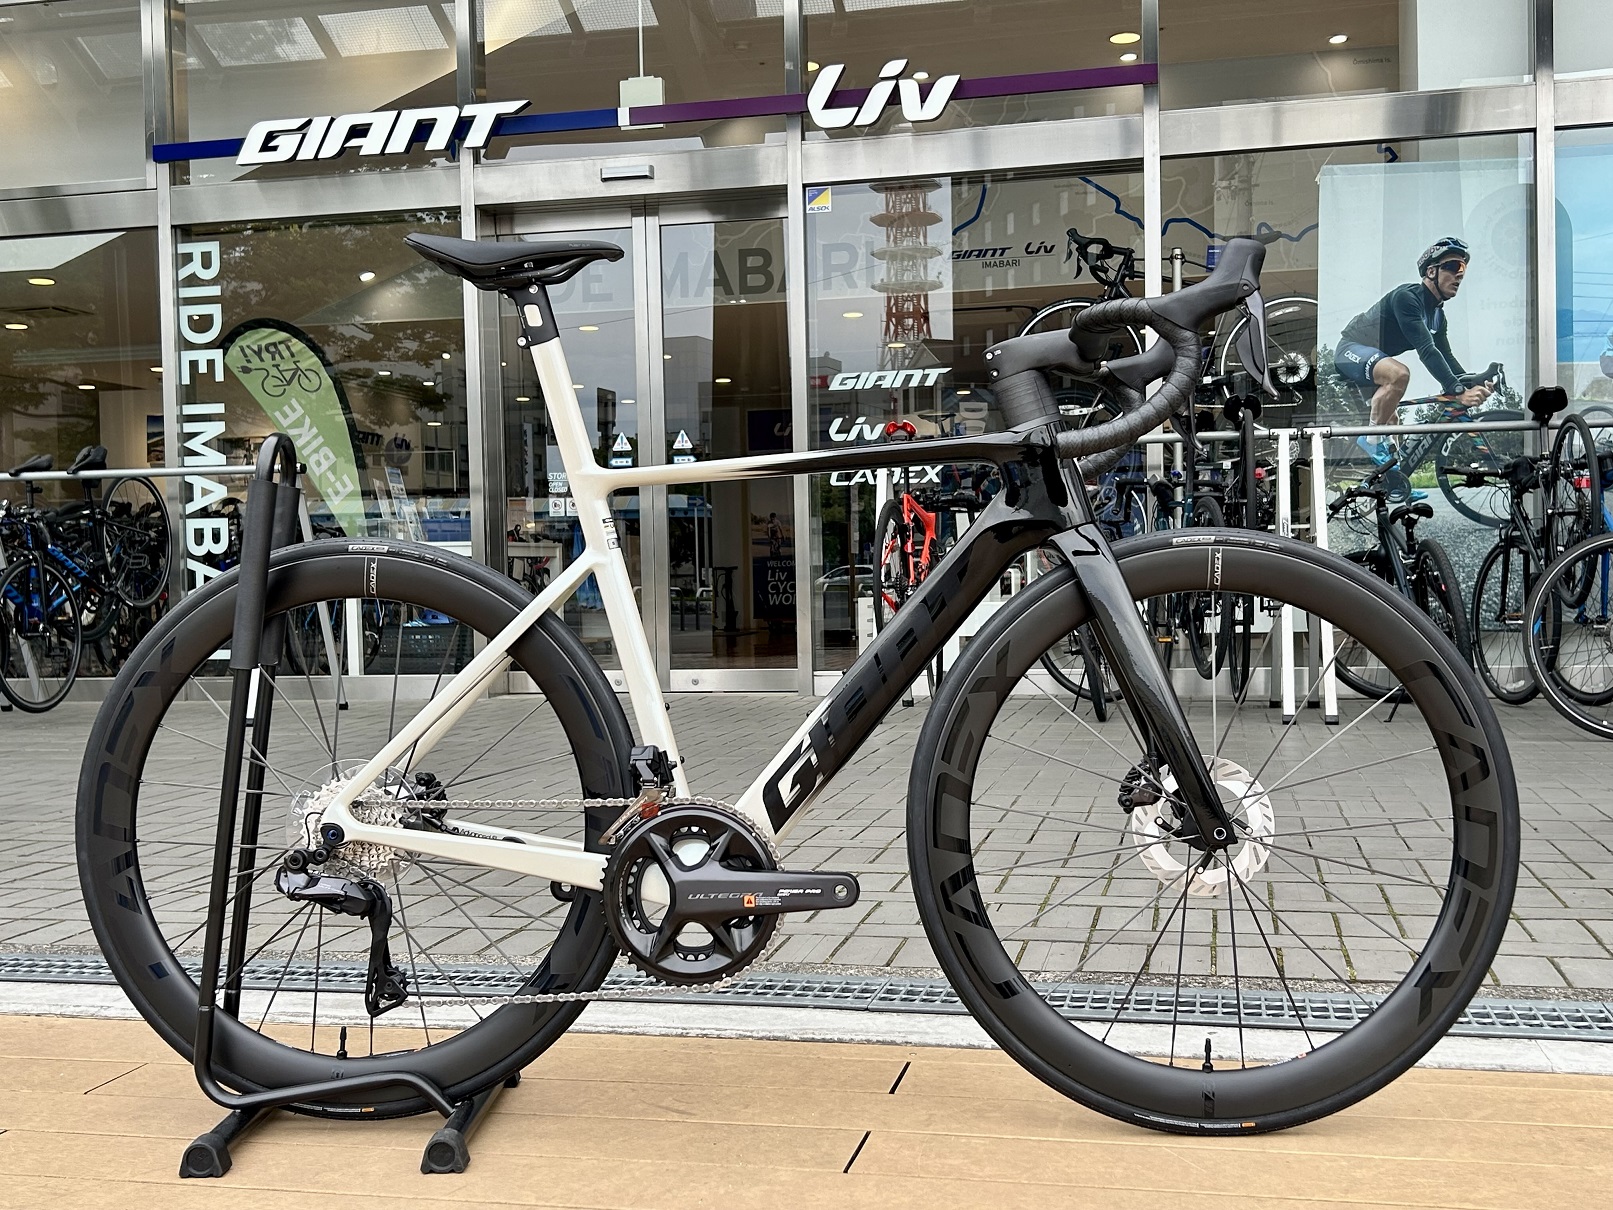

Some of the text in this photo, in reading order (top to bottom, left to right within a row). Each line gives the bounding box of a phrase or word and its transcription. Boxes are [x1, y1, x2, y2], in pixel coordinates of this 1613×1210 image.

[807, 59, 961, 129] Liv
[236, 99, 532, 165] GIANT
[951, 241, 1056, 259] GIANT Liv
[982, 259, 1020, 269] IMABARI
[178, 241, 225, 386] RIDE
[829, 368, 952, 390] GIANT
[829, 417, 885, 441] Liv
[1408, 433, 1438, 468] GIAN
[548, 472, 567, 480] STOR
[369, 561, 378, 594] CADEX
[767, 569, 788, 581] Liv
[1213, 551, 1222, 586] CADEX
